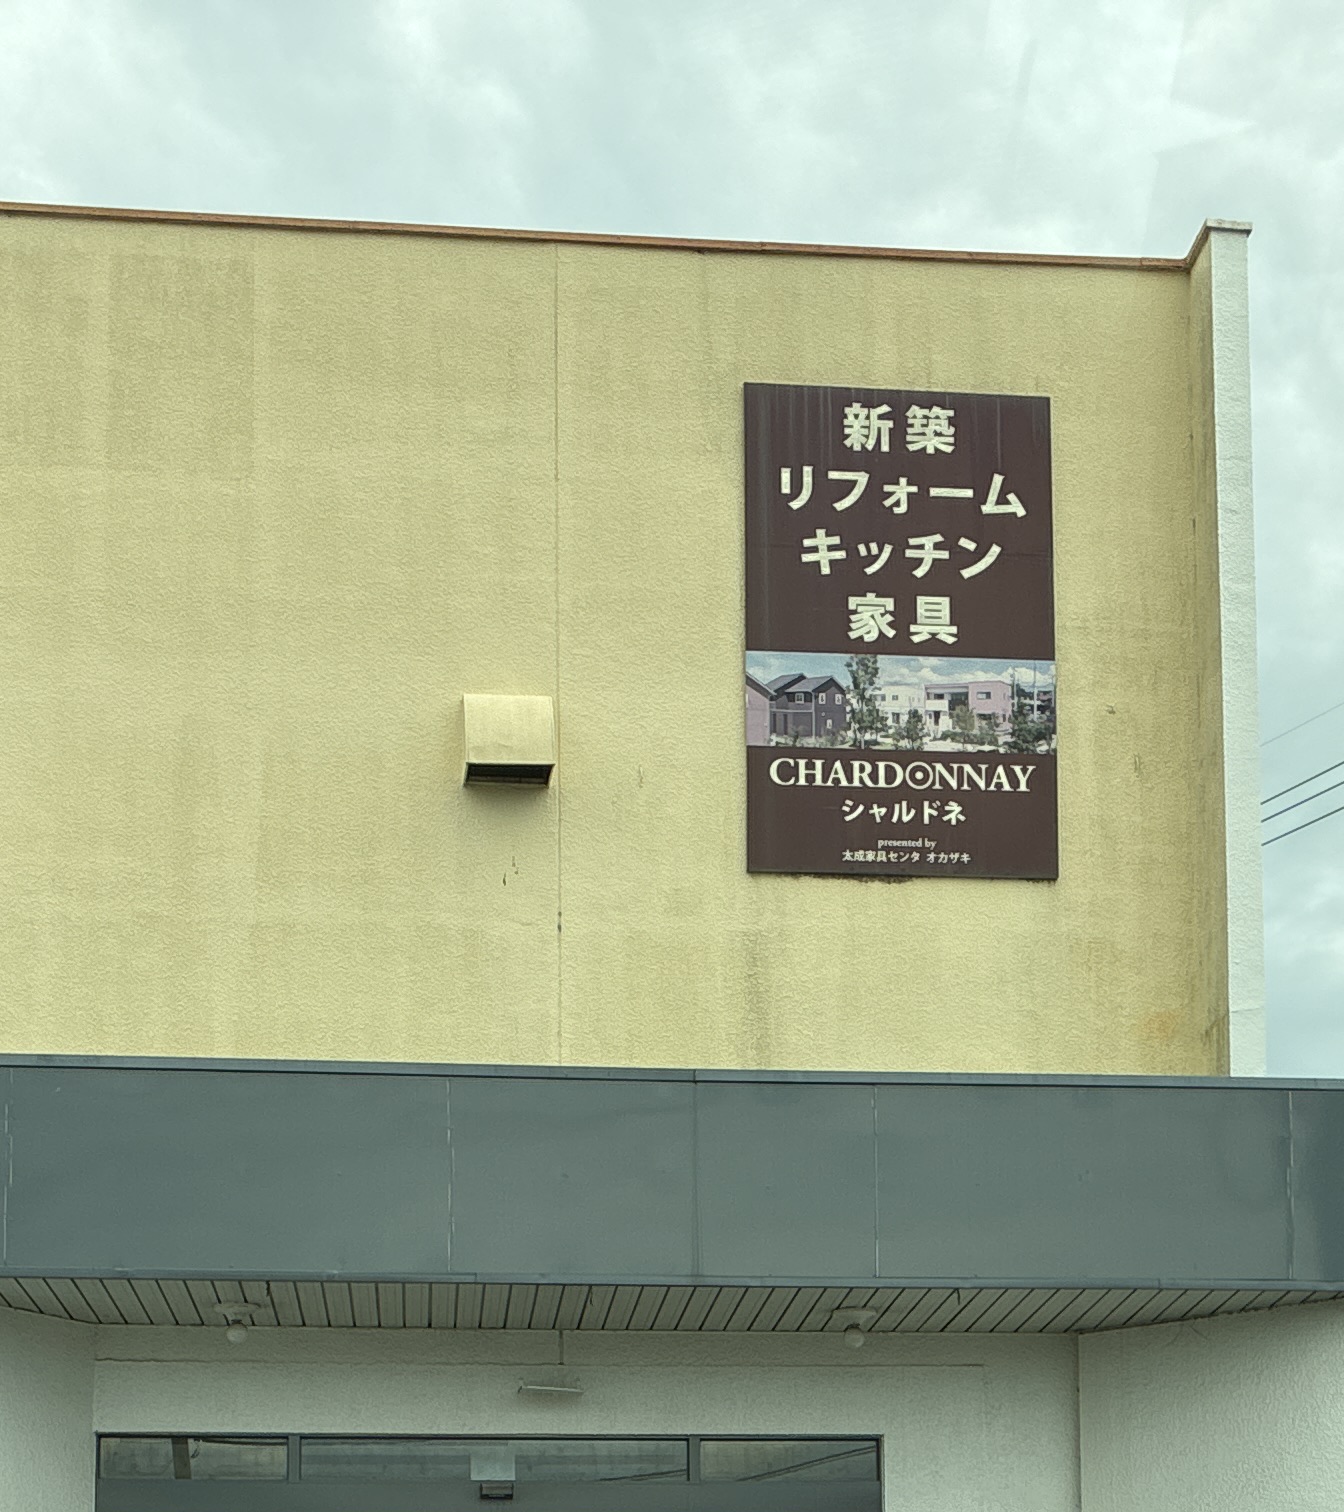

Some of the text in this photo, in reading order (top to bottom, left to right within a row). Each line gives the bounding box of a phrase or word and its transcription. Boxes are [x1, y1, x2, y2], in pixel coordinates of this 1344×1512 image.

[843, 402, 956, 454] 新築
[779, 465, 1027, 518] リフォーム
[800, 528, 1002, 580] キッチン
[847, 593, 958, 645] 家具
[768, 757, 1036, 792] CHARDONNAY
[841, 799, 966, 826] シャルドネ
[877, 837, 937, 850] presented by
[926, 852, 972, 864] オカザキ
